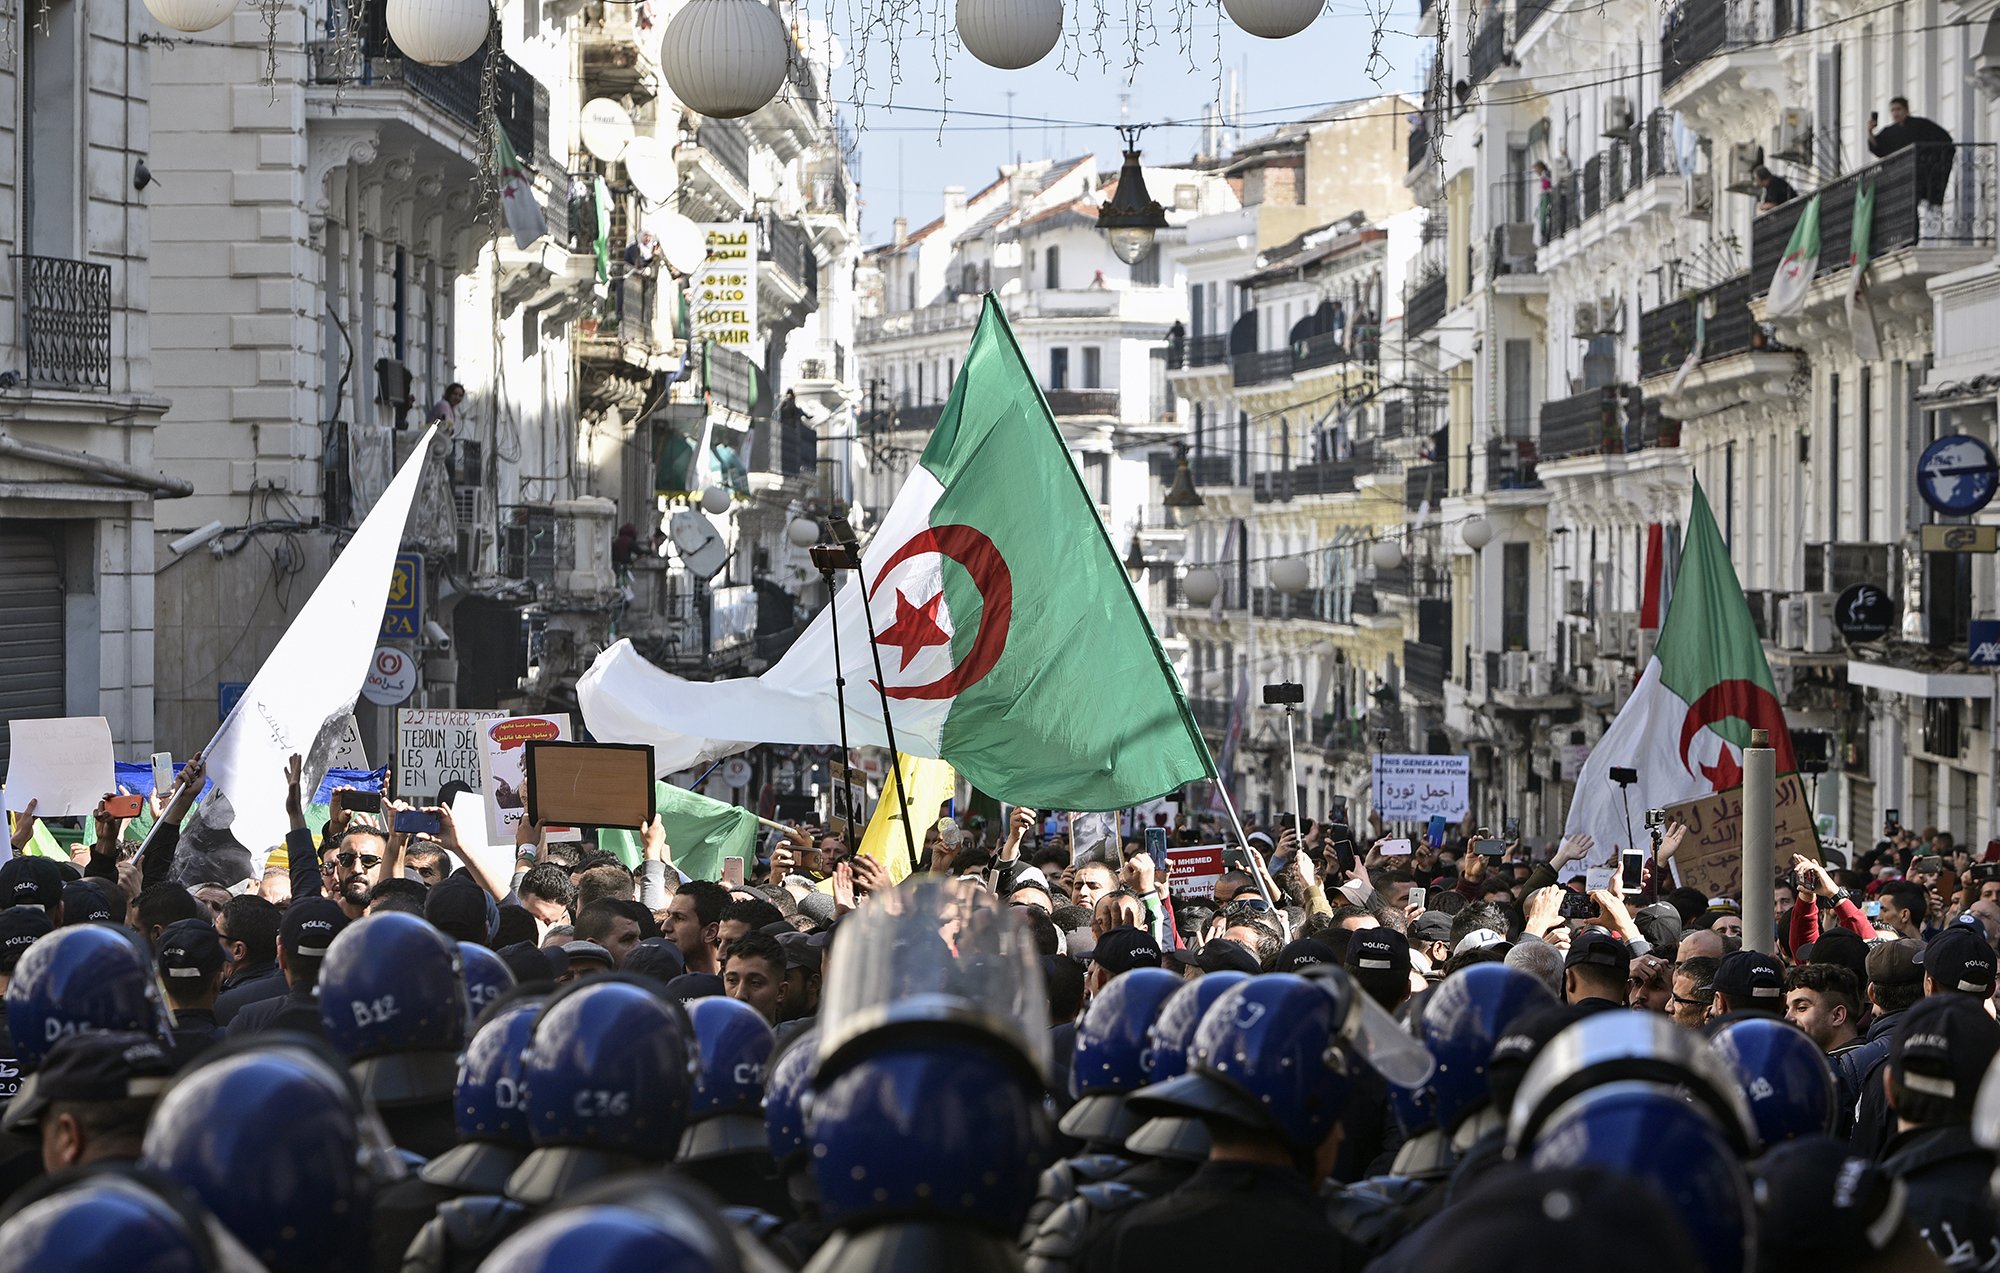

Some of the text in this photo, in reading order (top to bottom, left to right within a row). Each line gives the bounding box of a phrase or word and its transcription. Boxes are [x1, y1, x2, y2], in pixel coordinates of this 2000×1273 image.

[698, 311, 749, 323] HOTEL
[698, 330, 749, 343] SAMIR
[384, 614, 413, 634] PA
[404, 710, 425, 725] 22
[402, 729, 446, 748] TEBOUN
[401, 749, 424, 768] LES
[1402, 759, 1463, 767] GENERATION
[405, 770, 427, 787] EN
[1178, 856, 1212, 866] MHEMED
[1171, 867, 1195, 875] LHADI
[14, 882, 38, 892] POLICE
[1170, 878, 1190, 886] ERTÉ
[1188, 885, 1215, 893] JUSTIC
[301, 921, 333, 931] POLICE
[1362, 942, 1390, 951] POLICE
[1130, 948, 1157, 960] POLICE
[1294, 956, 1322, 967] POLICE
[1964, 960, 1990, 970] POLICE
[351, 994, 400, 1028] B12
